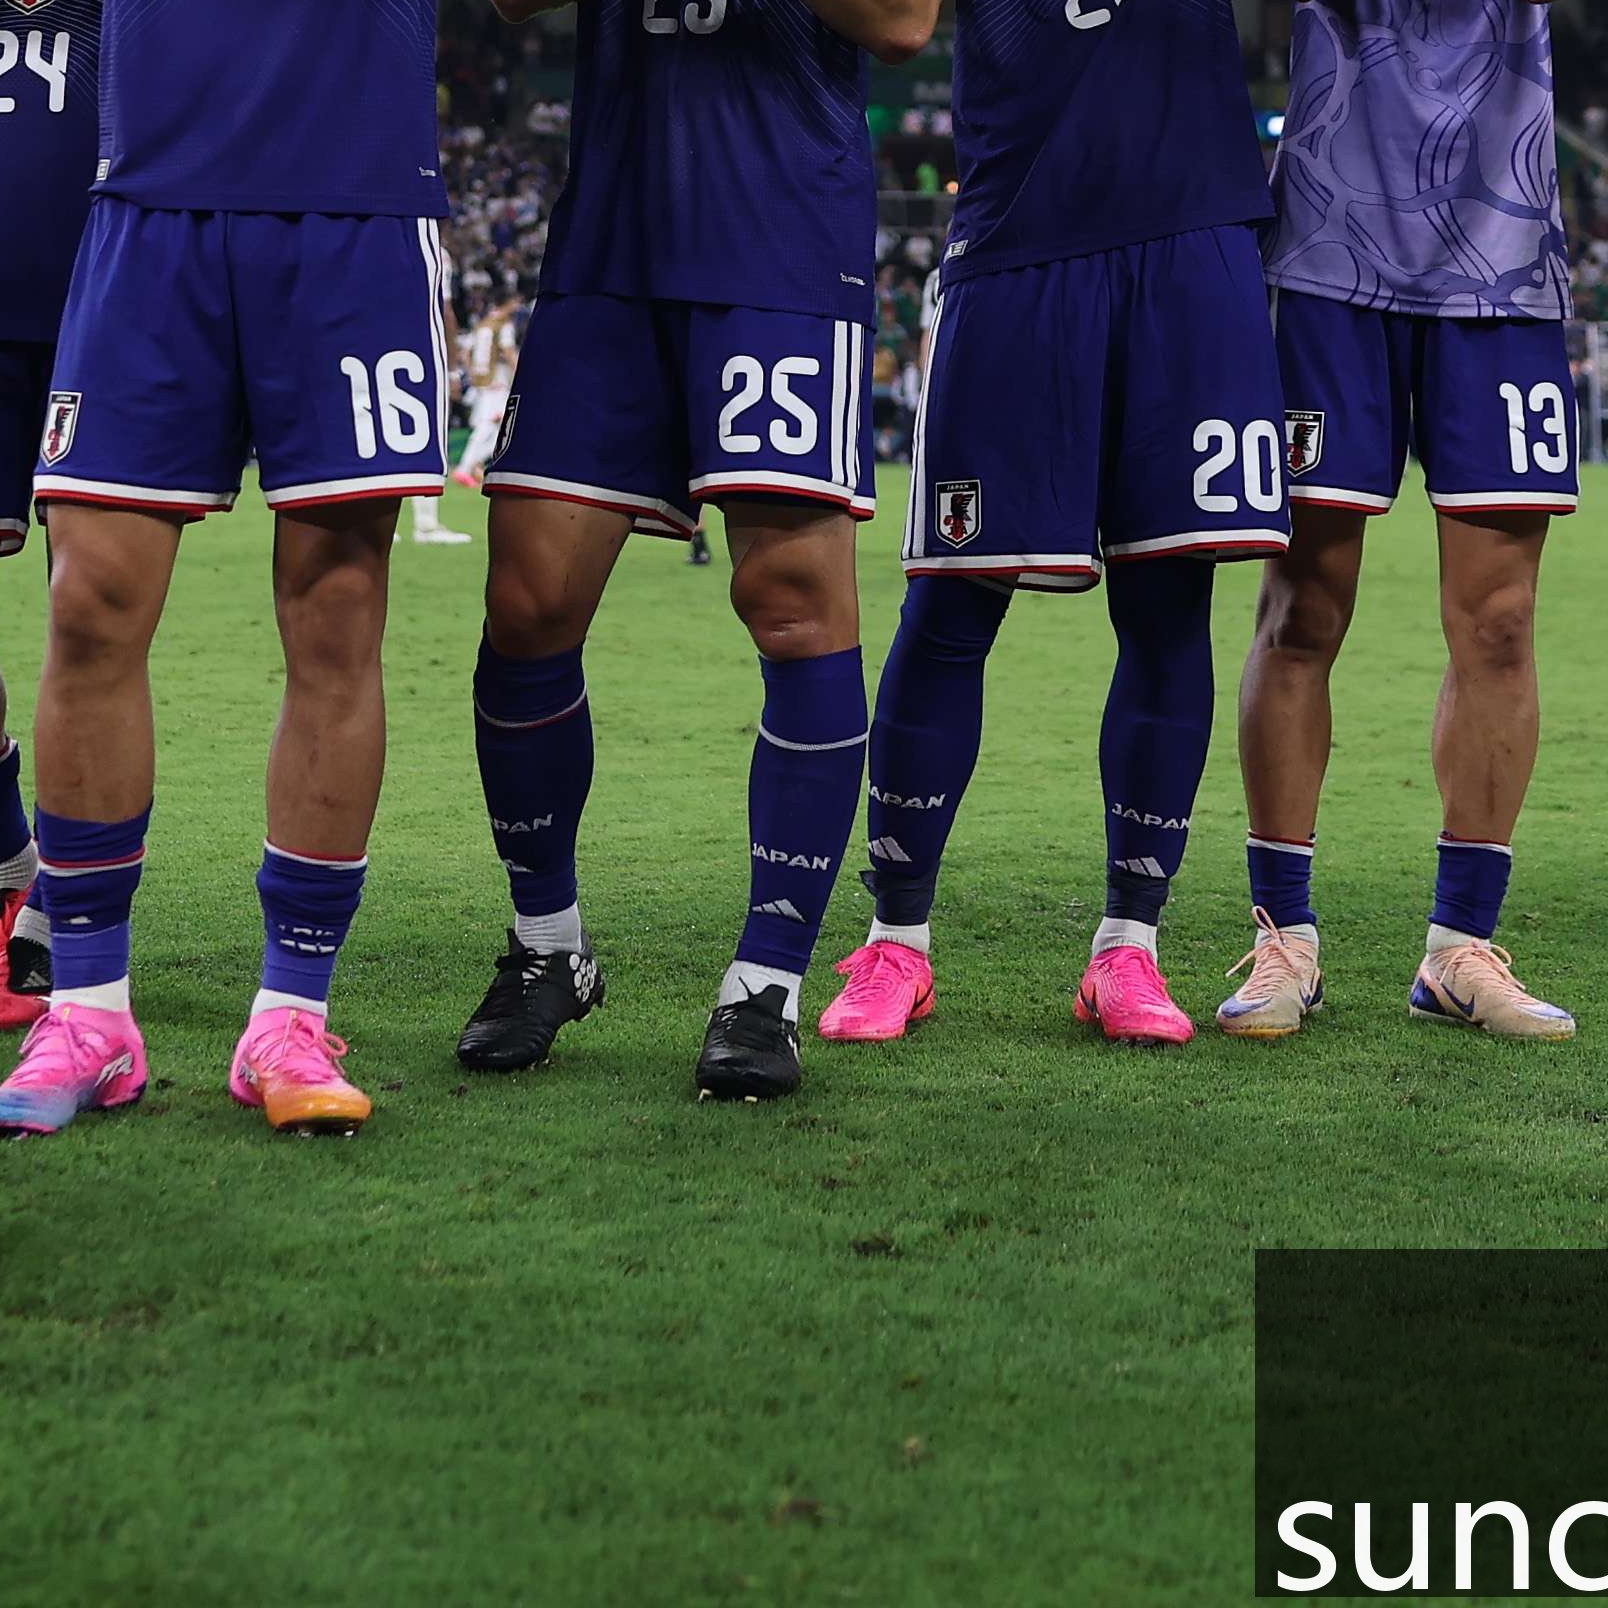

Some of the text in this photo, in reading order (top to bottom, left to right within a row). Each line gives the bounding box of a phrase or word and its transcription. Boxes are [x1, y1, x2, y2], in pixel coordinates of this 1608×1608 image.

[339, 349, 431, 460] 16
[718, 354, 820, 456] 25
[1290, 413, 1314, 421] JAPAN
[1498, 381, 1569, 475] 13
[947, 483, 970, 491] JAPAN
[1192, 418, 1282, 513] 20
[494, 813, 553, 834] PAN
